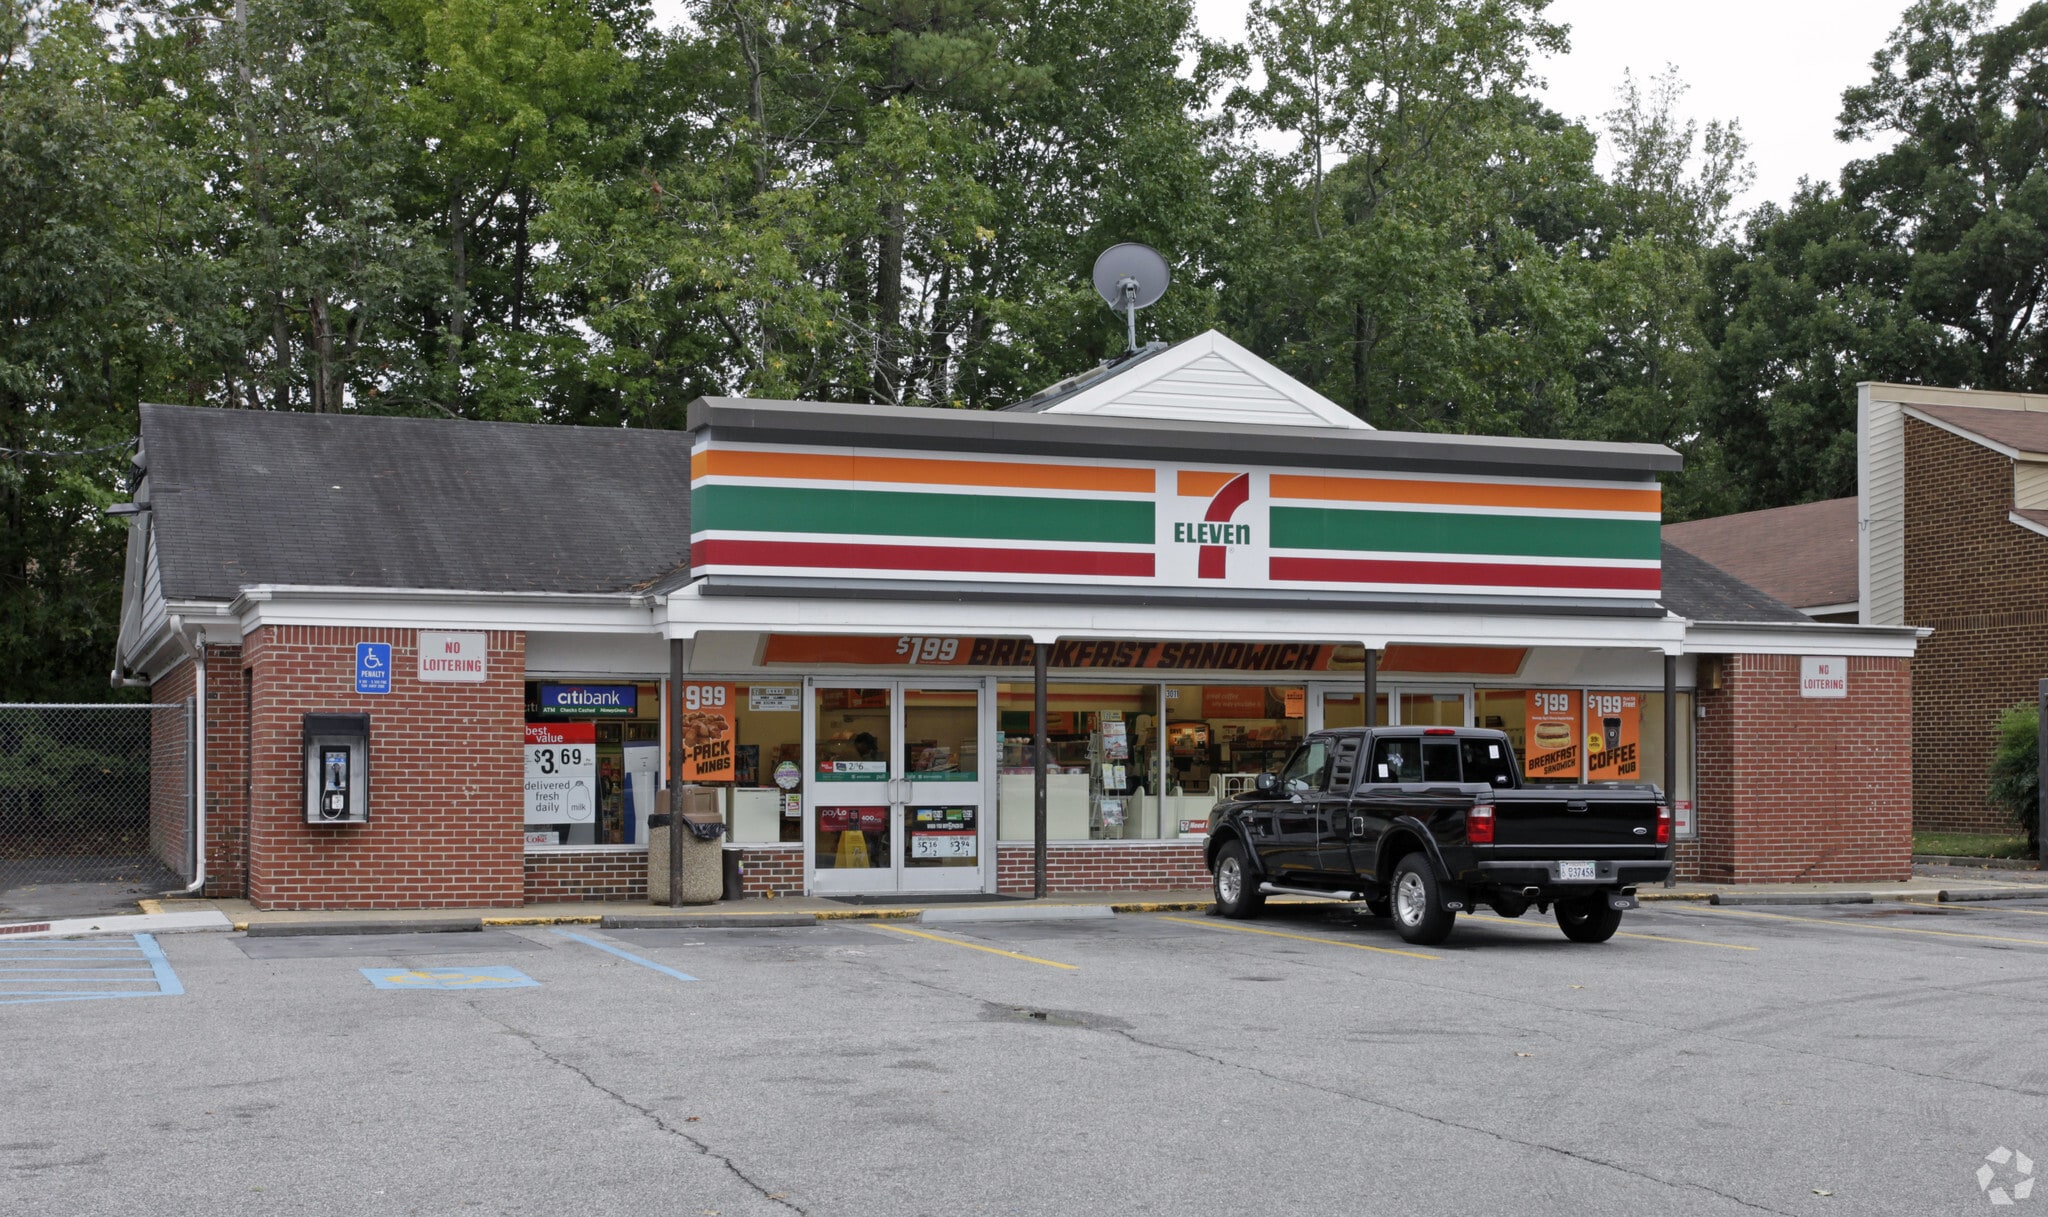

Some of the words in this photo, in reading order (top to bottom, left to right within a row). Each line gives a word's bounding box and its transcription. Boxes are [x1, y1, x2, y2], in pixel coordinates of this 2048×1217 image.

[1198, 472, 1249, 579] 7
[445, 641, 461, 654] NO
[1157, 642, 1321, 670] SANDWICH
[423, 658, 481, 672] LOITERING
[1818, 664, 1830, 675] NO
[361, 670, 386, 678] PENALTY
[1804, 679, 1844, 690] LOITERING
[557, 690, 620, 705] citibank
[682, 685, 726, 710] 999
[1535, 692, 1568, 715] $199
[1588, 694, 1622, 718] $199
[525, 726, 548, 736] best
[536, 733, 564, 743] value
[669, 740, 730, 768] -PACK
[1529, 745, 1577, 770] BREAKFAST
[1589, 743, 1636, 772] COFFEE
[1544, 758, 1576, 775] SANDWICH
[524, 780, 570, 791] delivered
[535, 791, 560, 801] fresh
[535, 802, 560, 814] daily
[571, 803, 586, 811] milk
